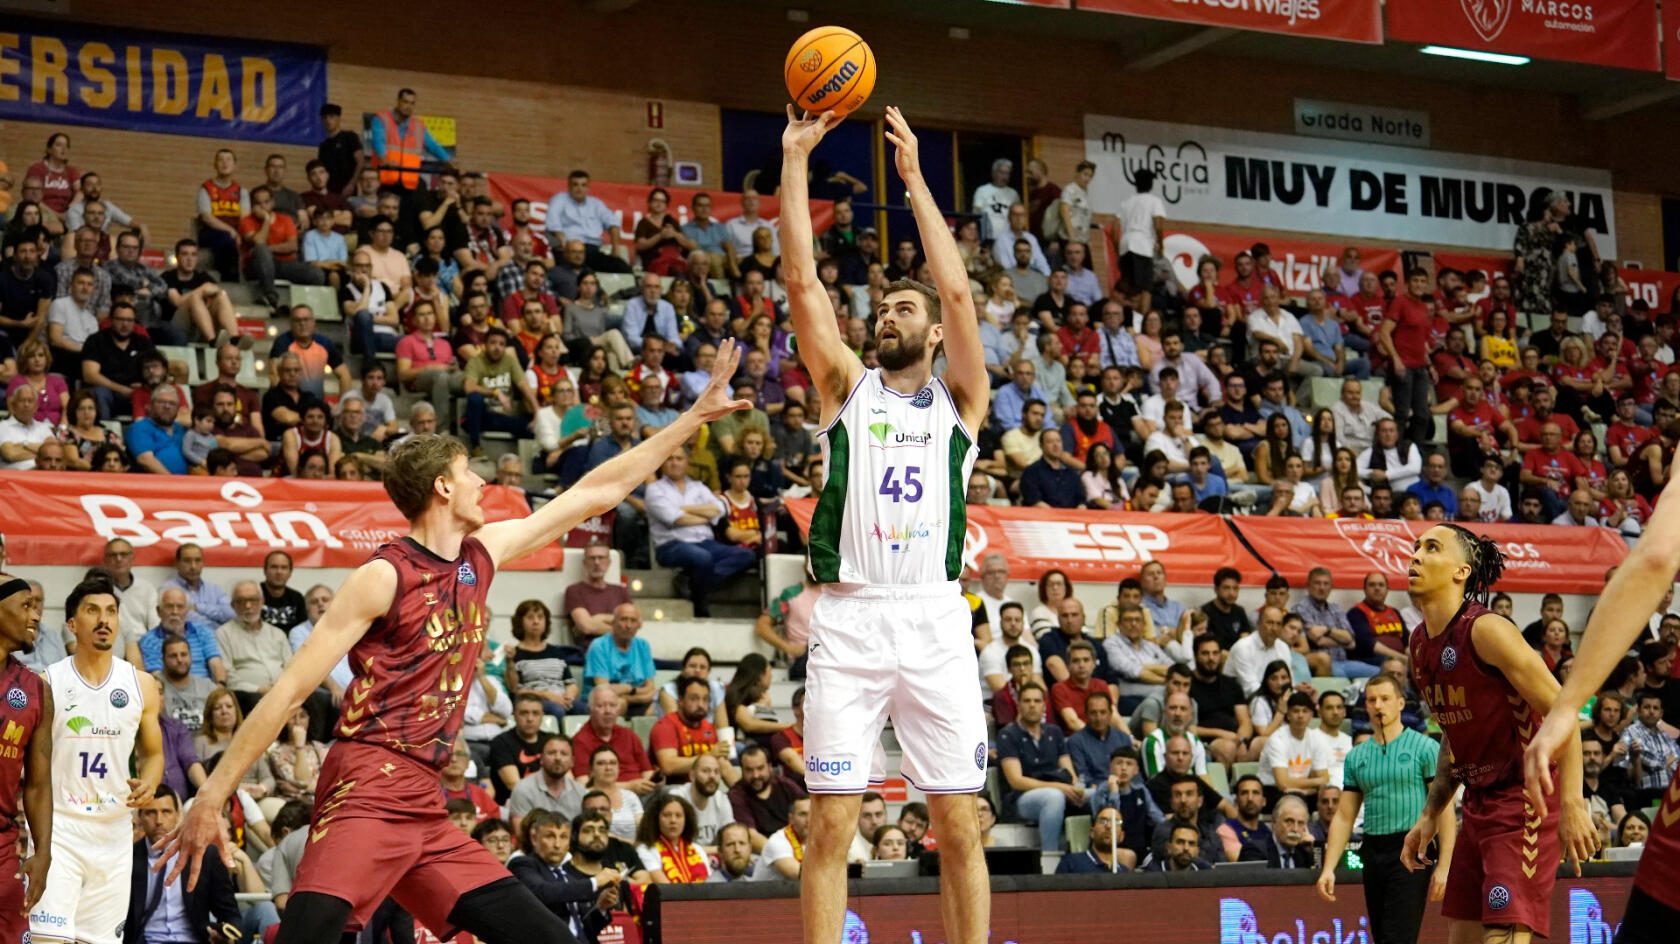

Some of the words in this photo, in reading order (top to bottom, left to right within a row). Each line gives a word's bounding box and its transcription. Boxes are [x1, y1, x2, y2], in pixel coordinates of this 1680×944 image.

[1521, 0, 1593, 20] MARCOS
[808, 61, 858, 104] Wilson
[1371, 115, 1423, 138] Norte
[1224, 155, 1337, 207] MUY
[1349, 169, 1408, 216] DE
[879, 465, 923, 502] 45
[1036, 521, 1169, 562] ESP
[79, 752, 108, 779] 14
